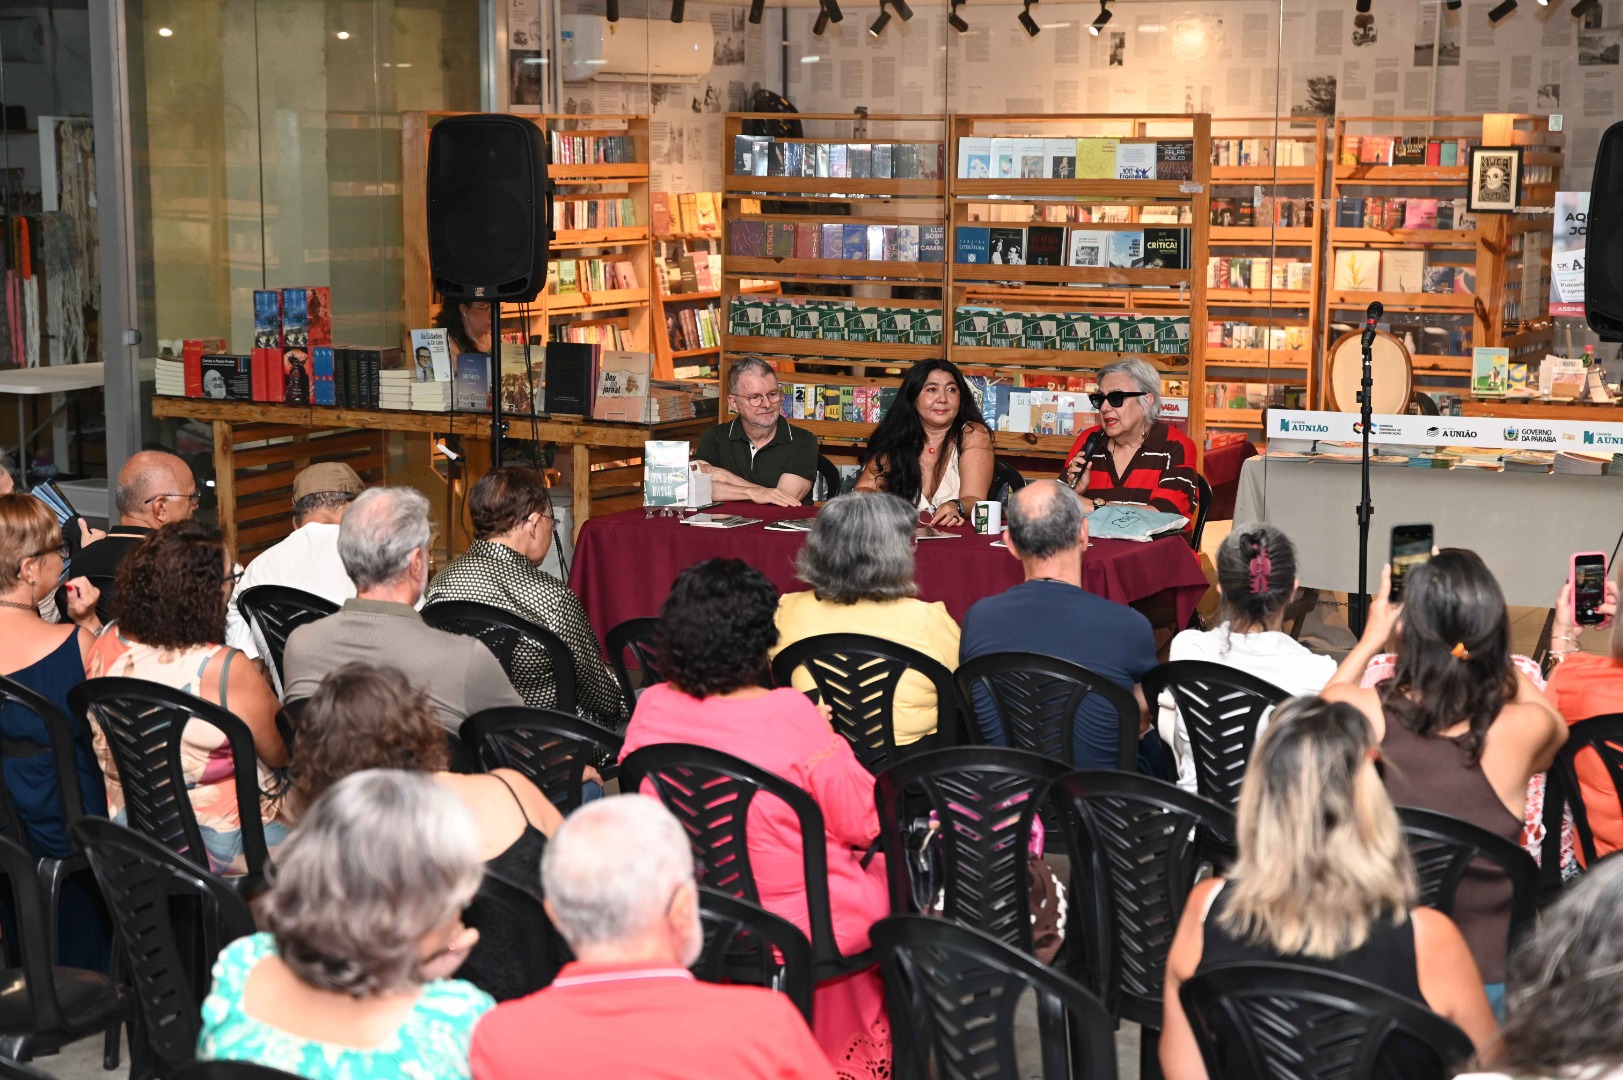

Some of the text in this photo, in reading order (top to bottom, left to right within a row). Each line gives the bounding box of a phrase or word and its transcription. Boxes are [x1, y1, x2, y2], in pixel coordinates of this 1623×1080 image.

[1146, 239, 1178, 249] CRÍTICA!
[605, 372, 616, 382] Deu
[602, 385, 621, 394] jornal
[1449, 429, 1478, 438] UNIÃO
[1521, 428, 1552, 436] GOVERNO
[1530, 435, 1557, 443] PARAÍBA
